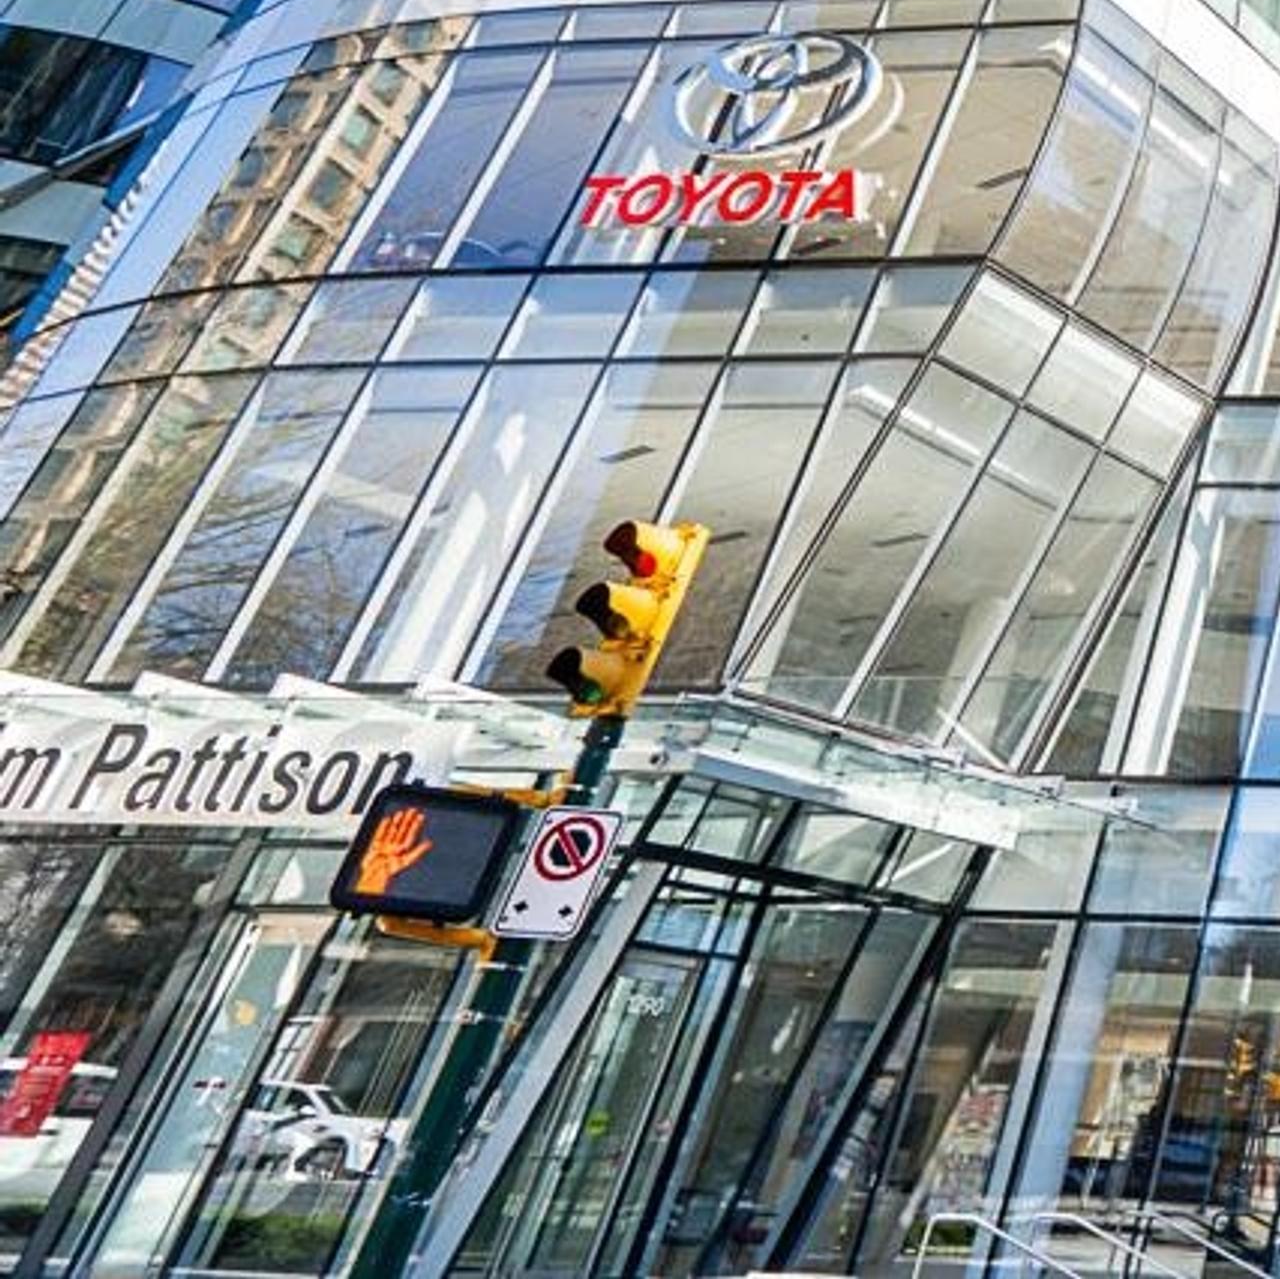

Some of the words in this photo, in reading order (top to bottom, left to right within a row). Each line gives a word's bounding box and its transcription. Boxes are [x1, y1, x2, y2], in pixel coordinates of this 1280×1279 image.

[581, 168, 855, 226] TOYOTA
[0, 723, 61, 809] m
[69, 723, 414, 815] Pattison
